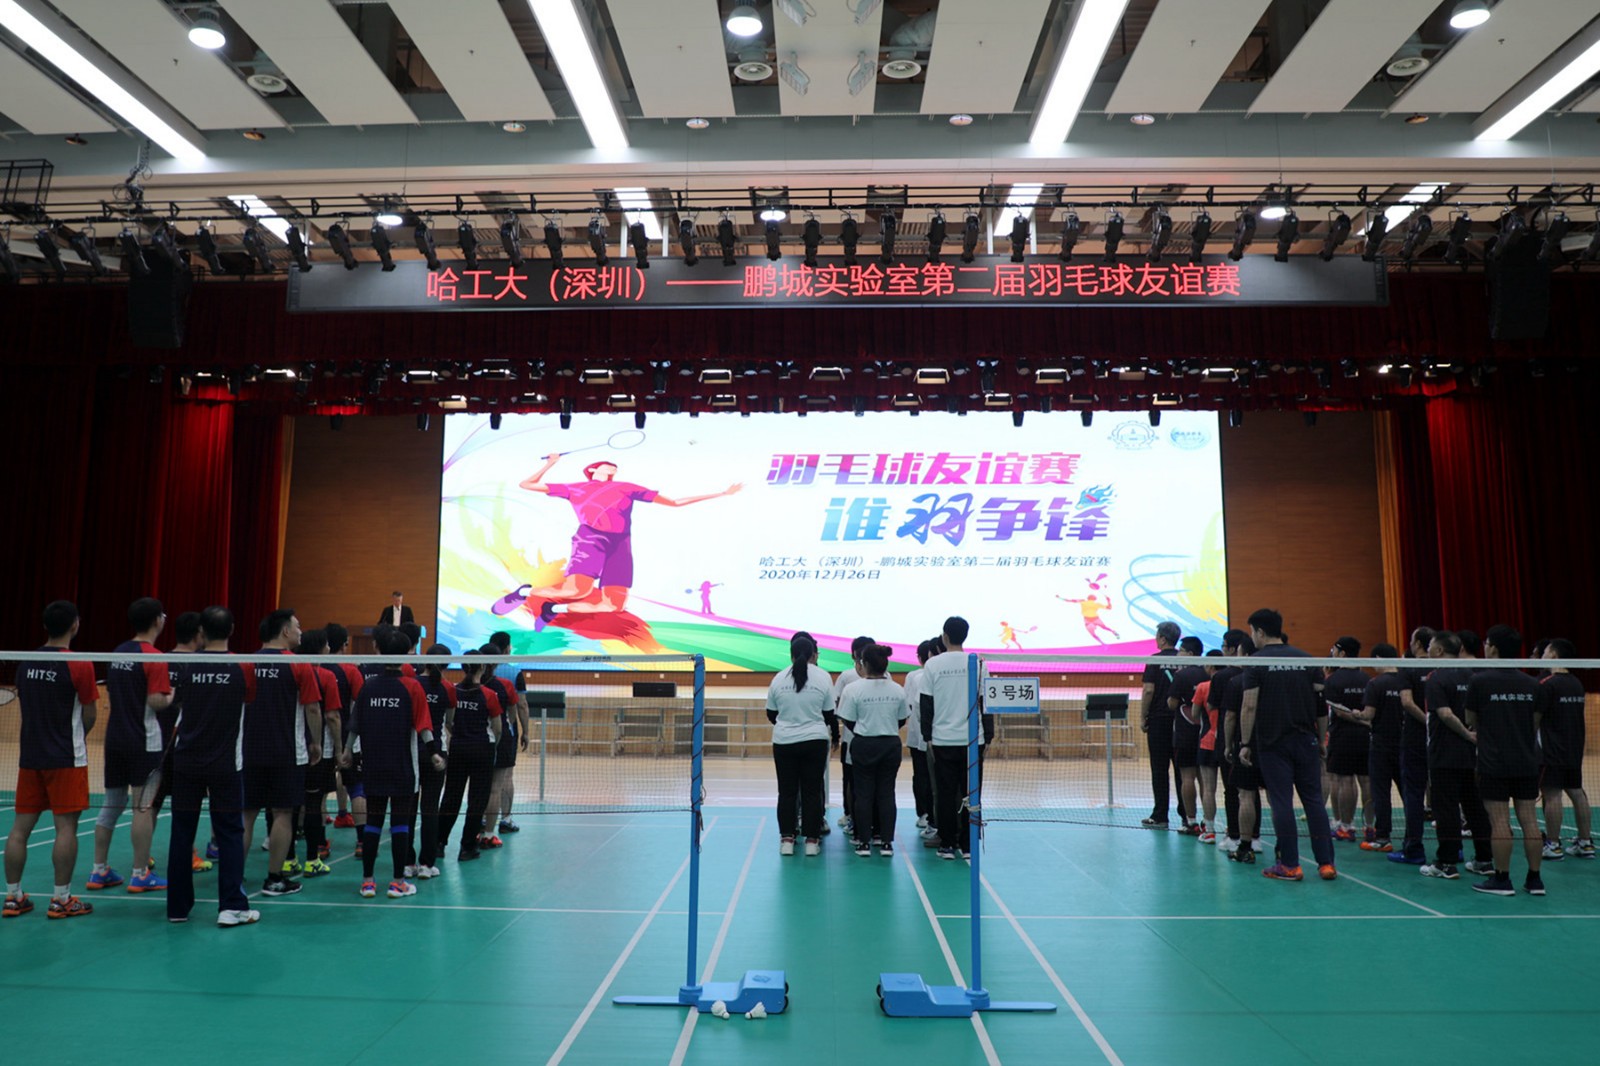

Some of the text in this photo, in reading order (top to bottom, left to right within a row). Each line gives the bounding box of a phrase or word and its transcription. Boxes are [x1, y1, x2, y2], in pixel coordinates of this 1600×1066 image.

[766, 452, 1081, 485] 羽毛球友谊赛
[819, 492, 1111, 547] 谁羽争锋
[758, 570, 881, 580] 2020年12月26日
[27, 668, 57, 682] HITSZ
[192, 673, 230, 684] HITSZ
[370, 697, 400, 708] HITSZ
